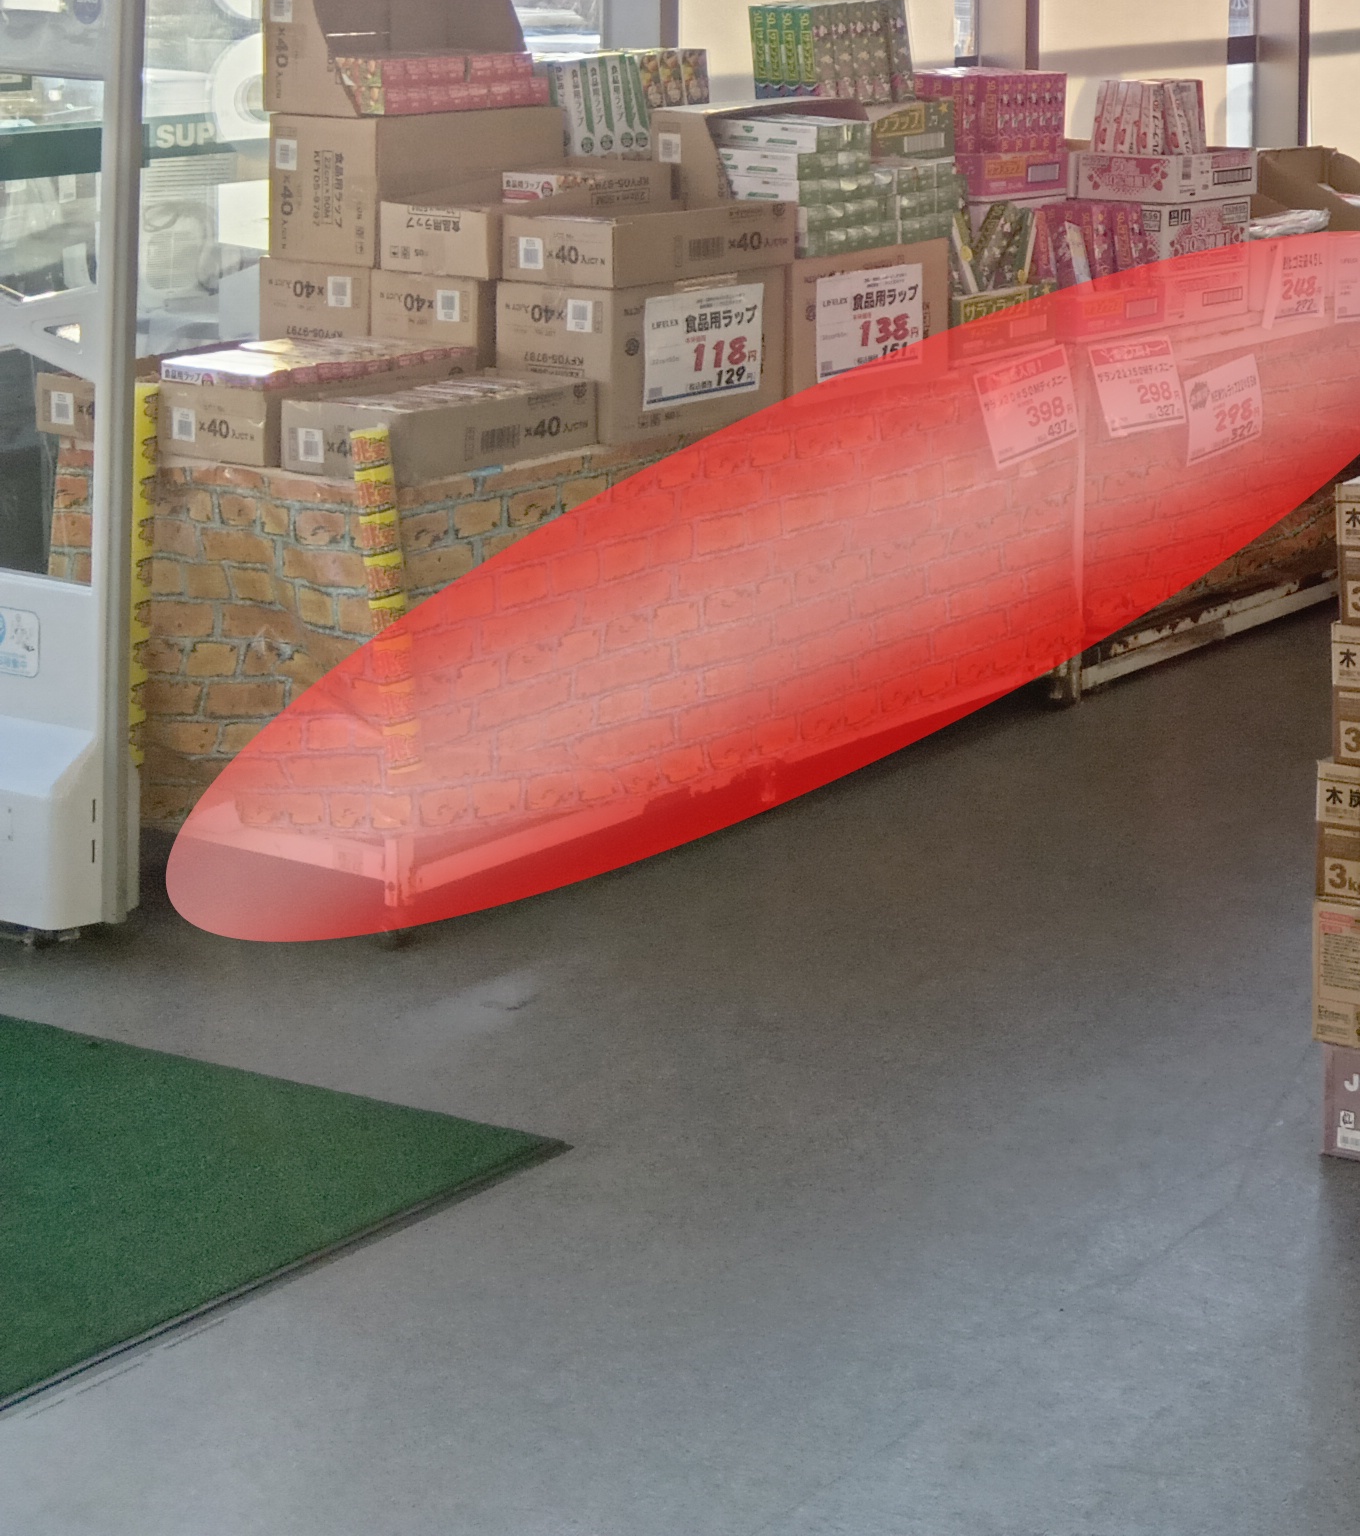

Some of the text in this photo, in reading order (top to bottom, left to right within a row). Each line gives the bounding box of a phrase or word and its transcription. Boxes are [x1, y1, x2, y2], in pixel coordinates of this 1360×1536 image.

[852, 284, 918, 311] 食品用ラップ
[685, 305, 758, 333] 食品用ラップ
